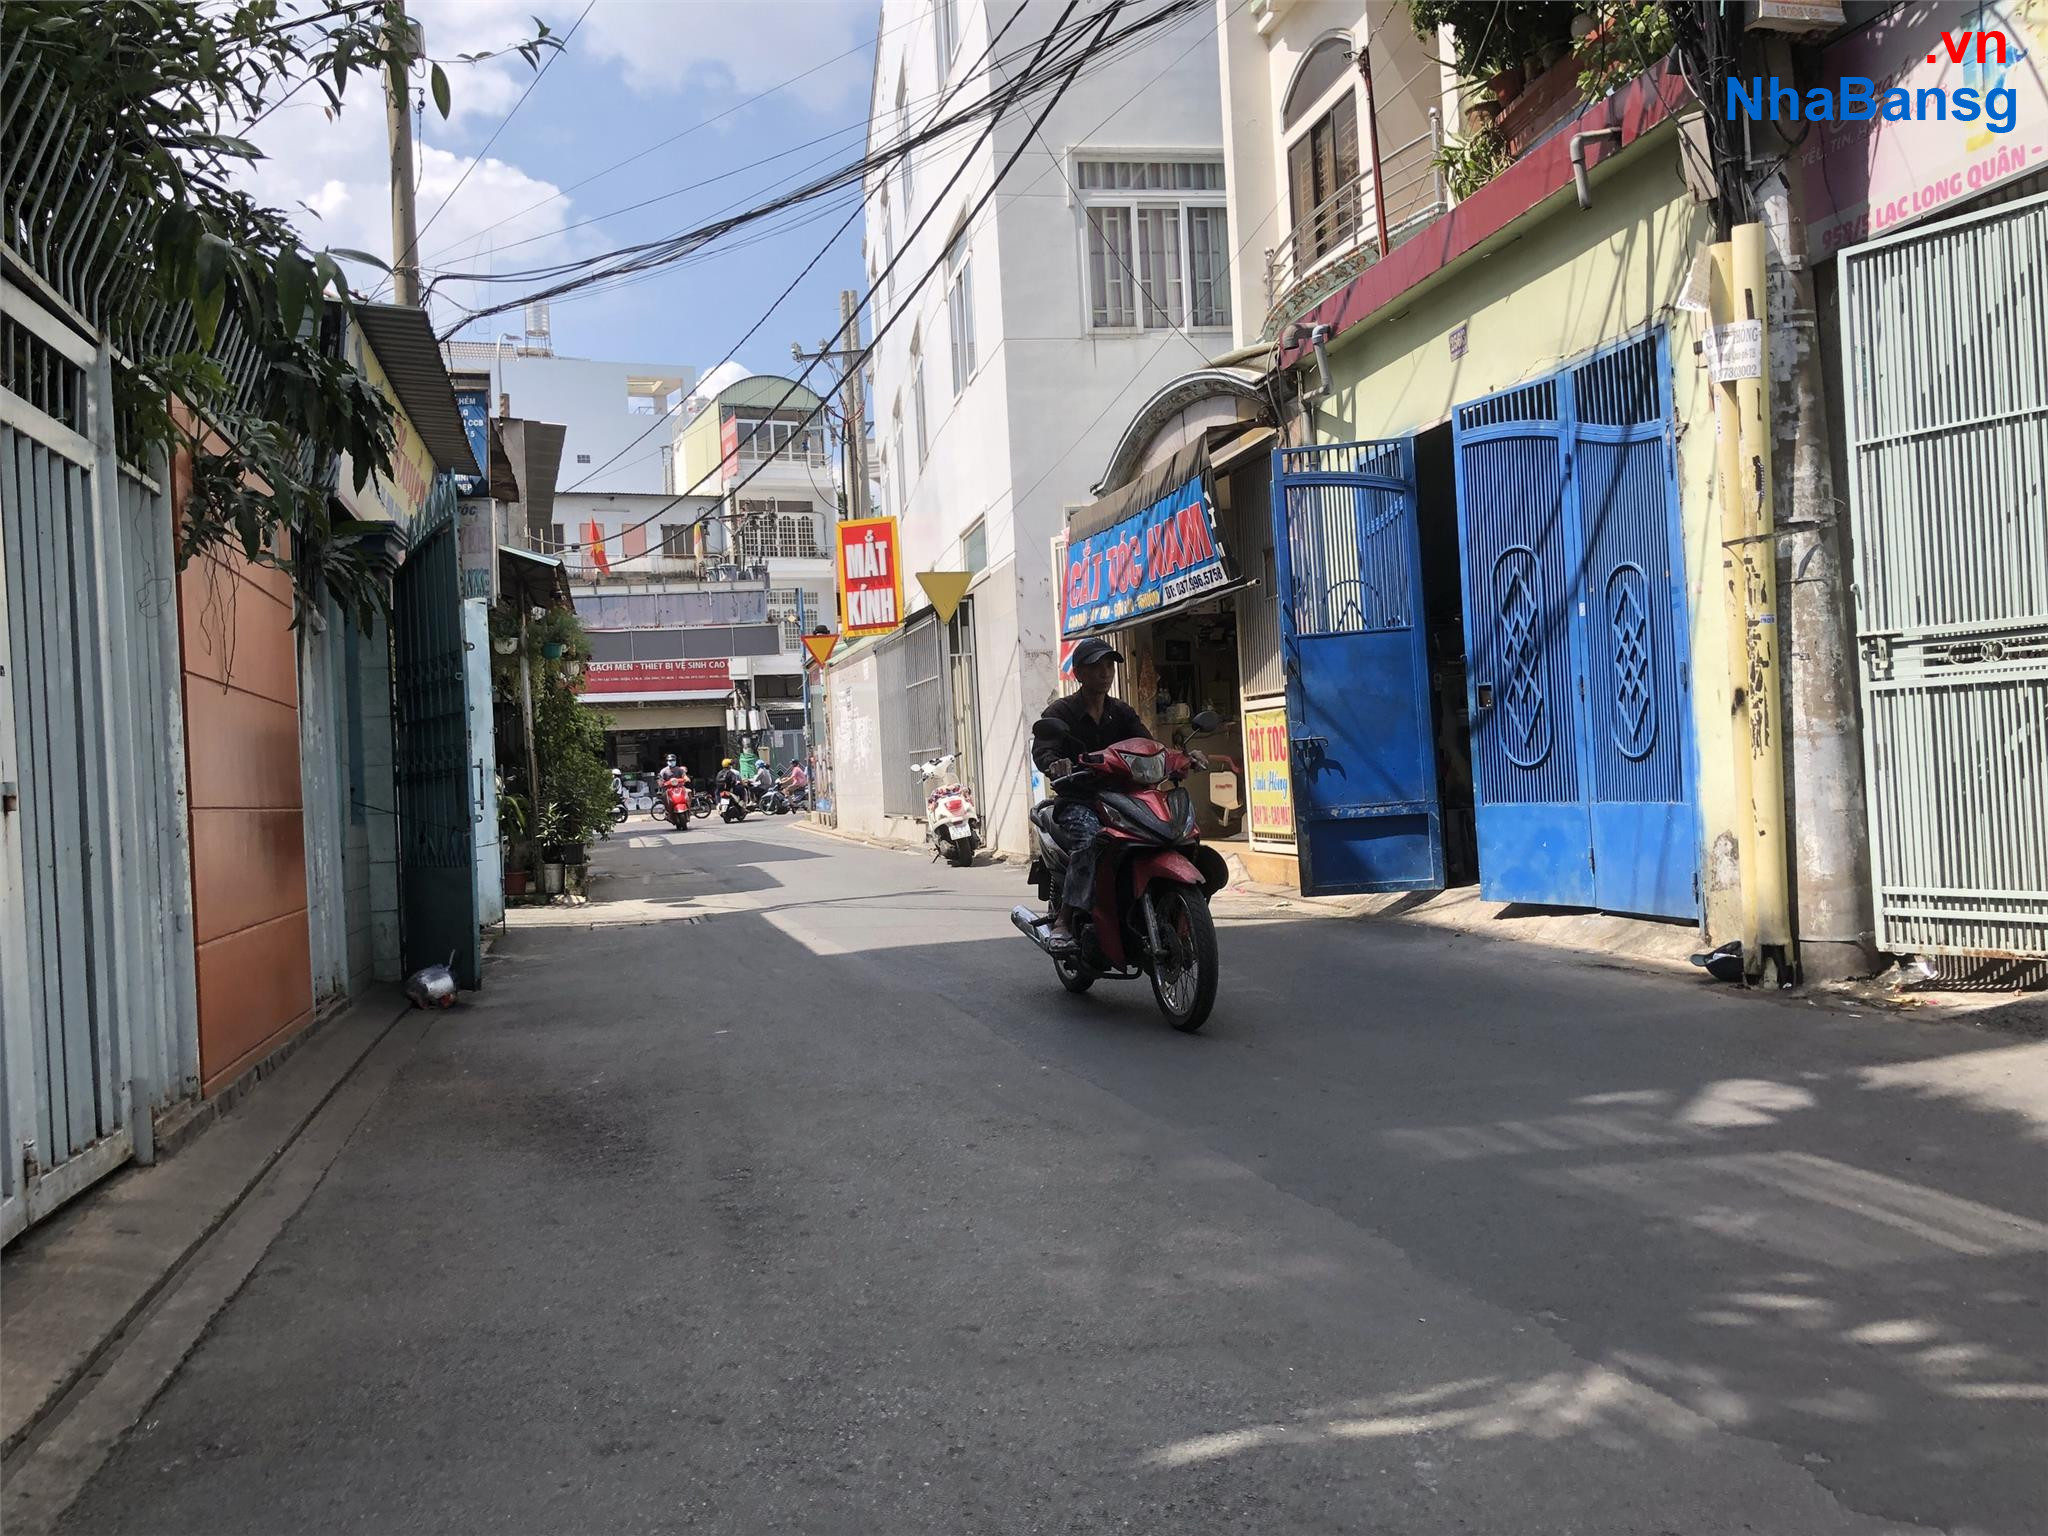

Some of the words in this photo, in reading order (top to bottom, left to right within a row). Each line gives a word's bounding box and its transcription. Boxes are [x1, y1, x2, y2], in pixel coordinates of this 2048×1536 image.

[1876, 195, 1908, 229] LẠC
[1912, 172, 1963, 213] LONG
[1966, 144, 2026, 190] QUÂN
[845, 528, 888, 579] MẮT
[1069, 537, 1102, 609] CẮT
[1106, 529, 1143, 597] TÓC
[1146, 500, 1215, 583] NAM
[846, 583, 896, 627] KÍNH
[687, 660, 707, 669] SINH
[708, 660, 726, 669] CAO
[1267, 717, 1288, 762] TÓC
